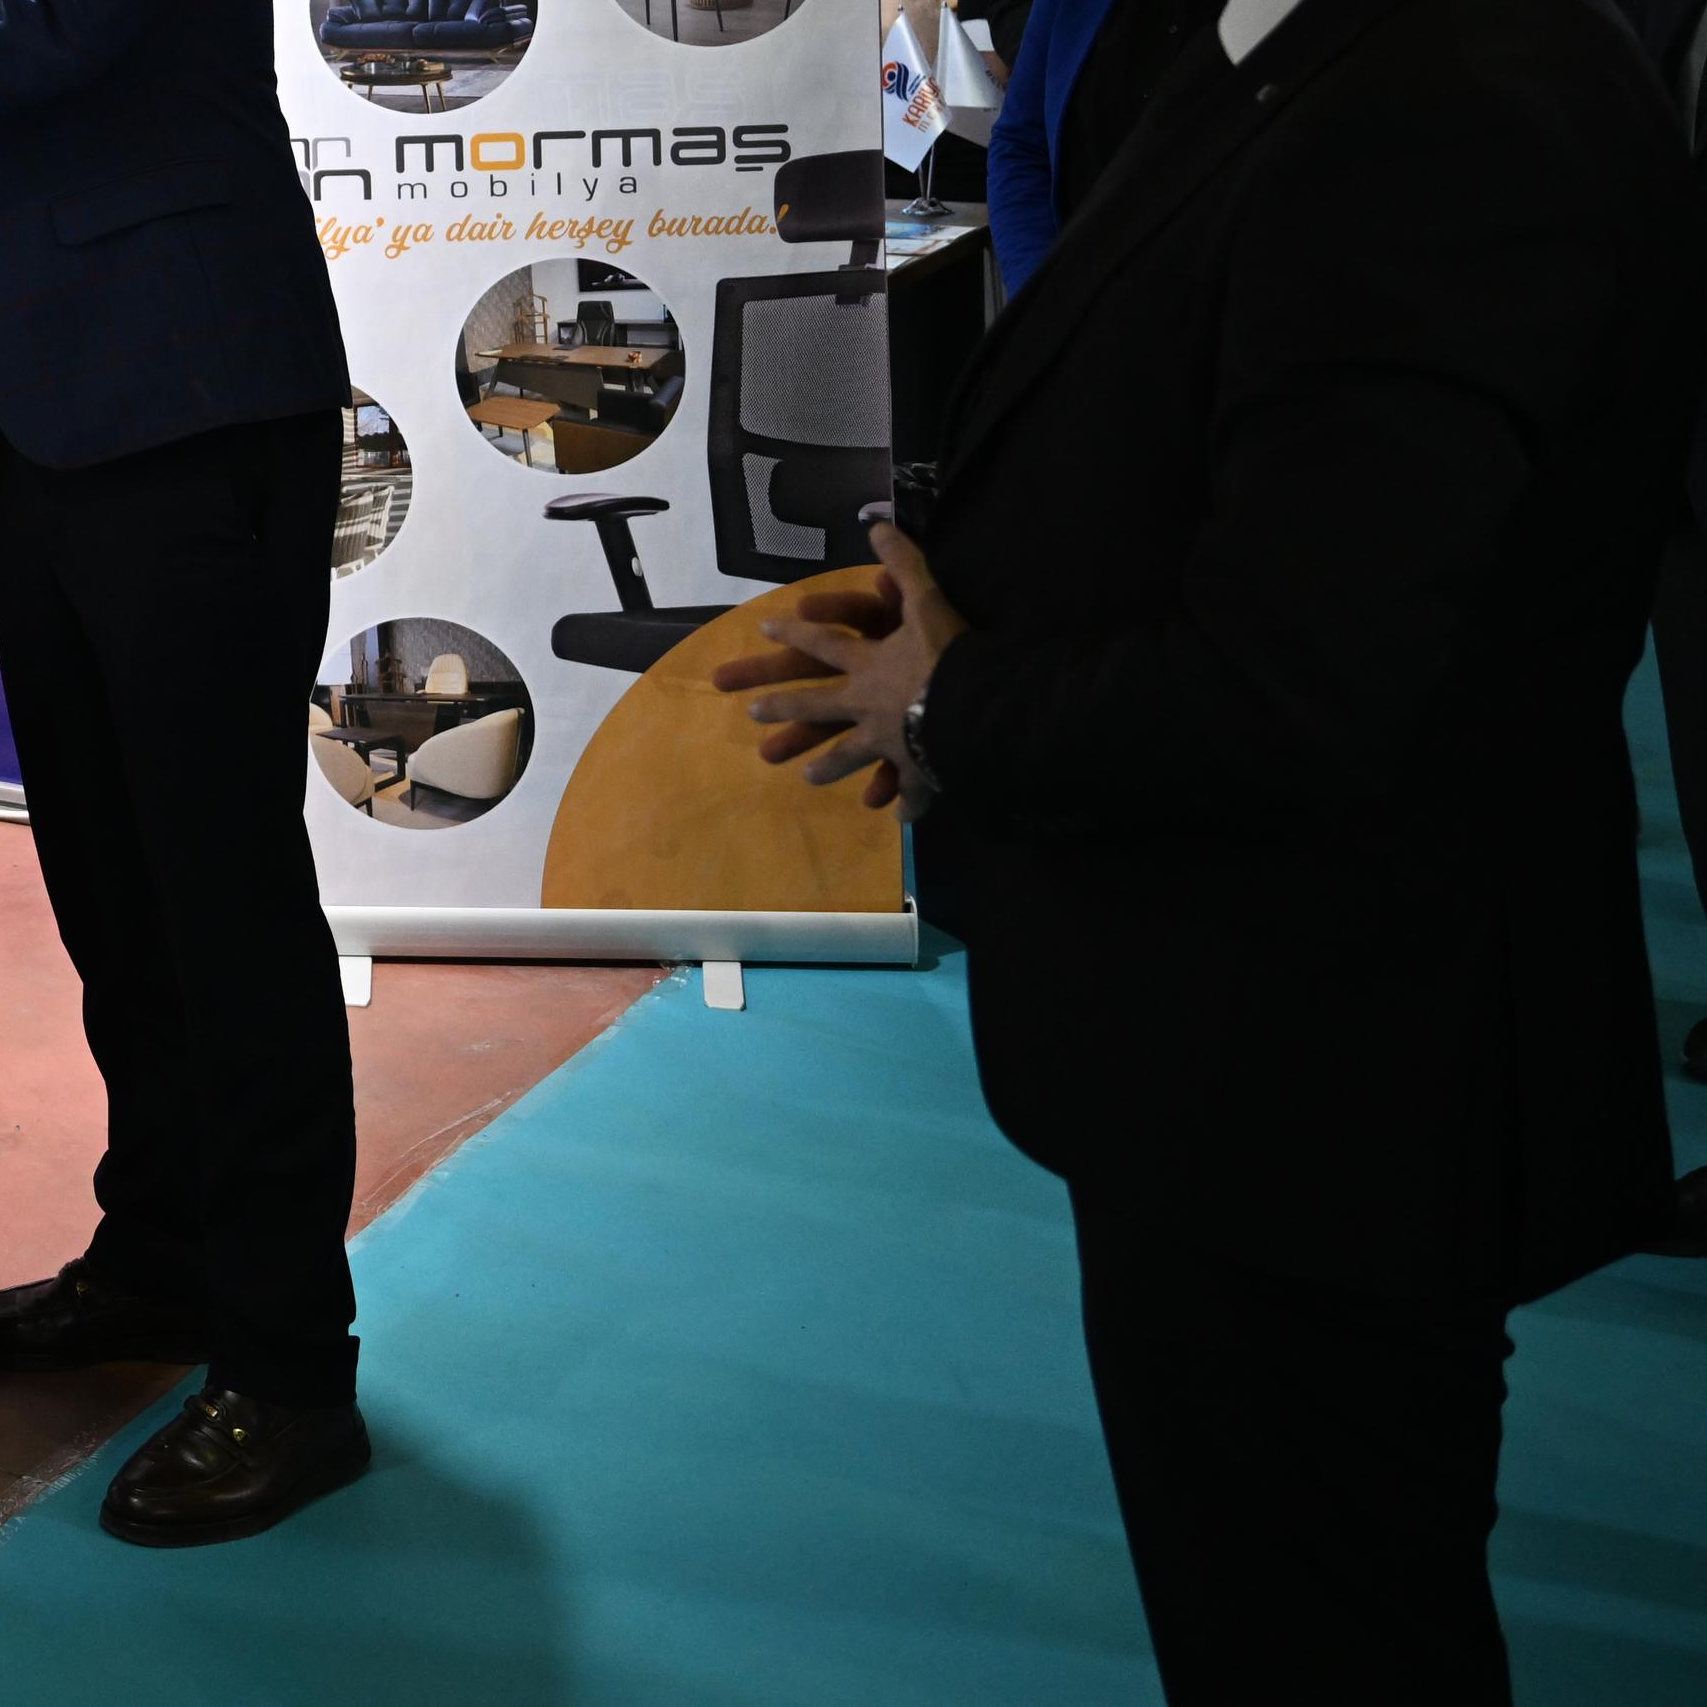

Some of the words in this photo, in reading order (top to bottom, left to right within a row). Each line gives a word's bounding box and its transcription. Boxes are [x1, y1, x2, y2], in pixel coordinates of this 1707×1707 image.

[395, 124, 791, 172] mormaş
[397, 172, 638, 202] mobilya
[445, 211, 517, 243] dair
[525, 209, 641, 255] herşey
[647, 203, 790, 239] burada!
